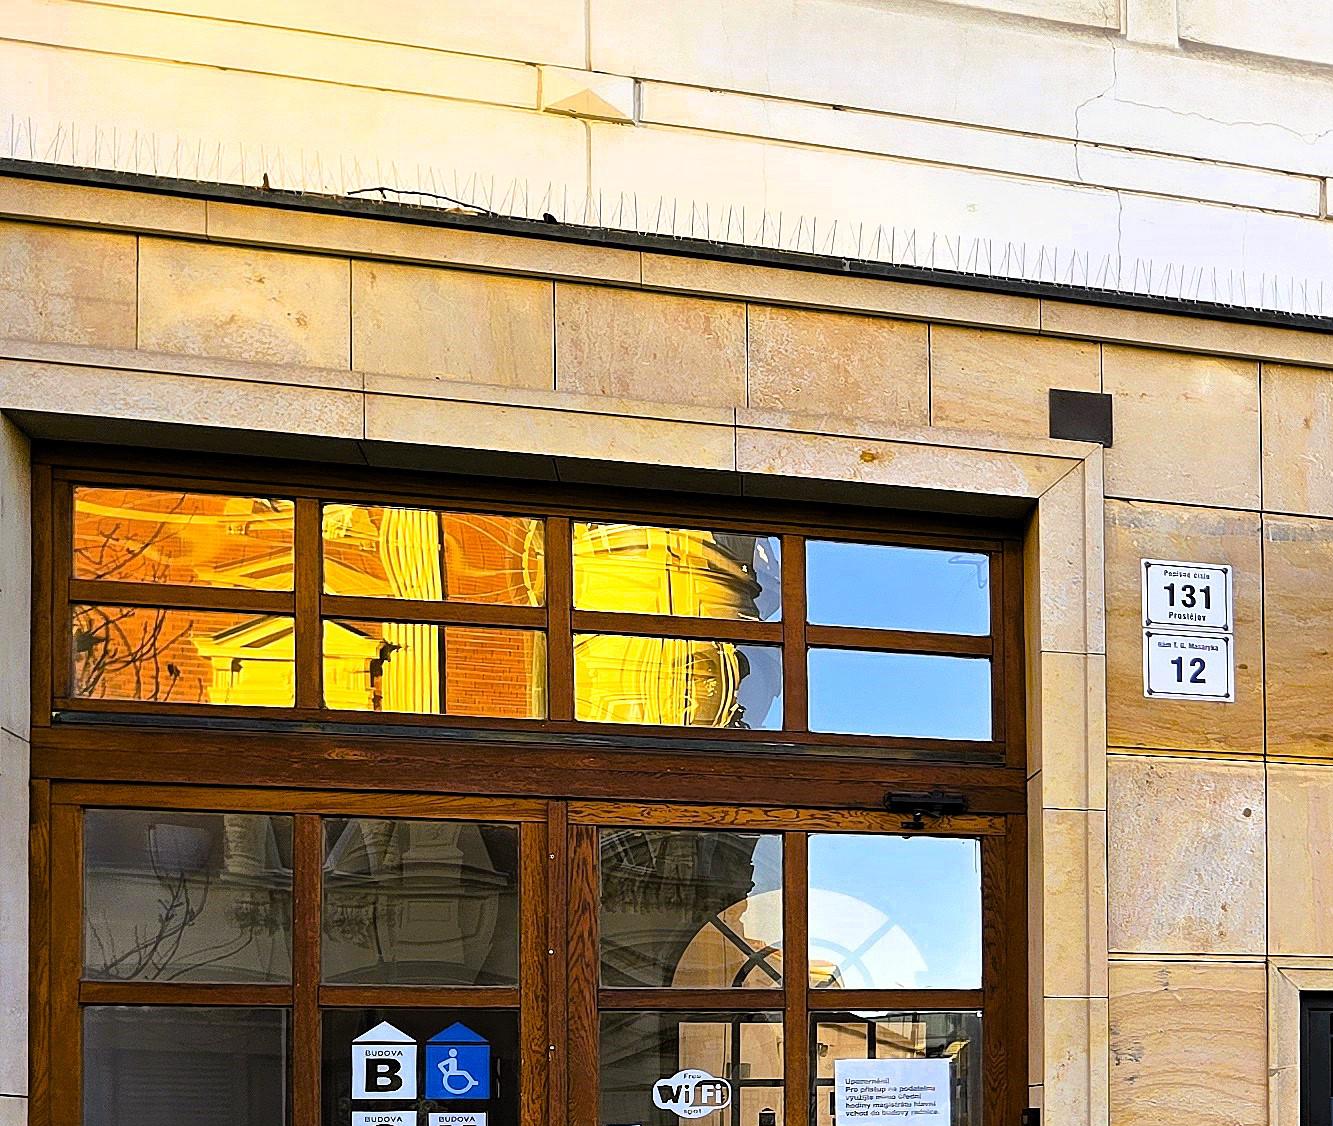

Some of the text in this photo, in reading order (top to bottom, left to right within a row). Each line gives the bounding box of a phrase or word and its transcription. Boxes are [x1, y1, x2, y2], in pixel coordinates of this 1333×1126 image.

[1164, 583, 1210, 610] 131
[1168, 612, 1206, 622] Prostějov
[1170, 656, 1206, 684] 12
[365, 1058, 402, 1092] B
